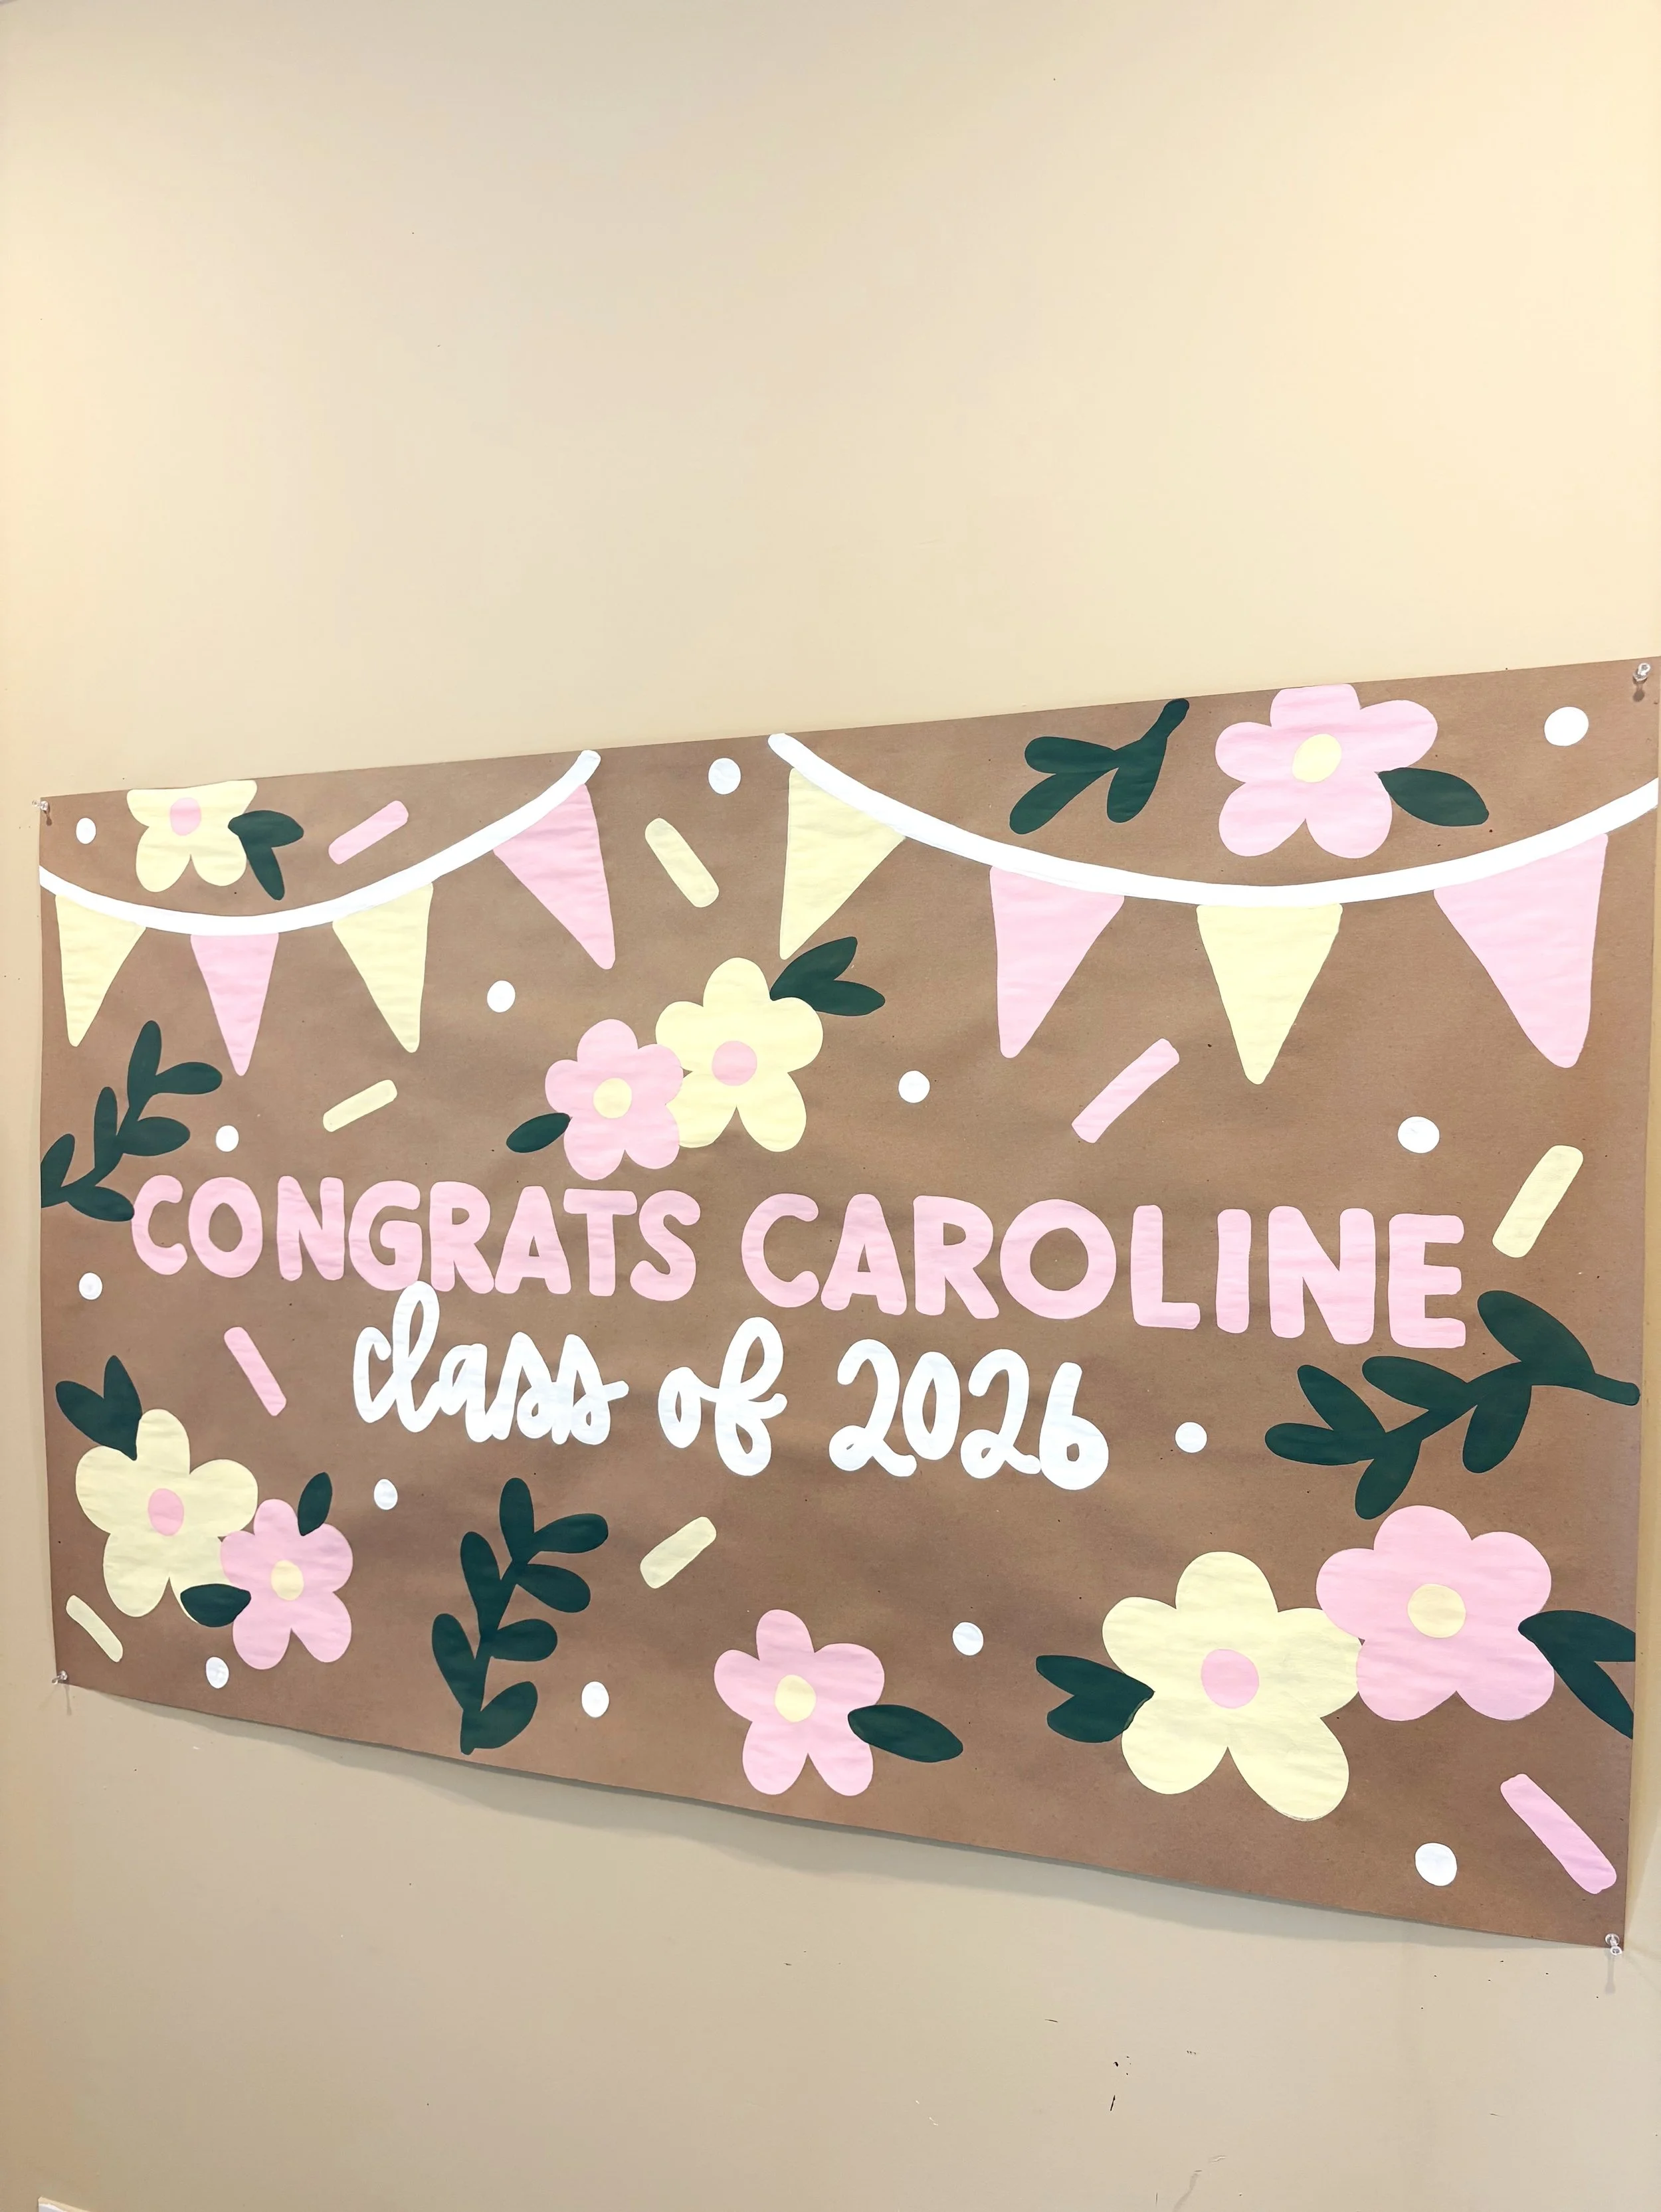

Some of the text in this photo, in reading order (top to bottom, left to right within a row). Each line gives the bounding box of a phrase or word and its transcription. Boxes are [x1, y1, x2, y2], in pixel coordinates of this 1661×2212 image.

[132, 1174, 1466, 1348] CONGRATS CAROLINE
[353, 1281, 1109, 1490] class of 2026
